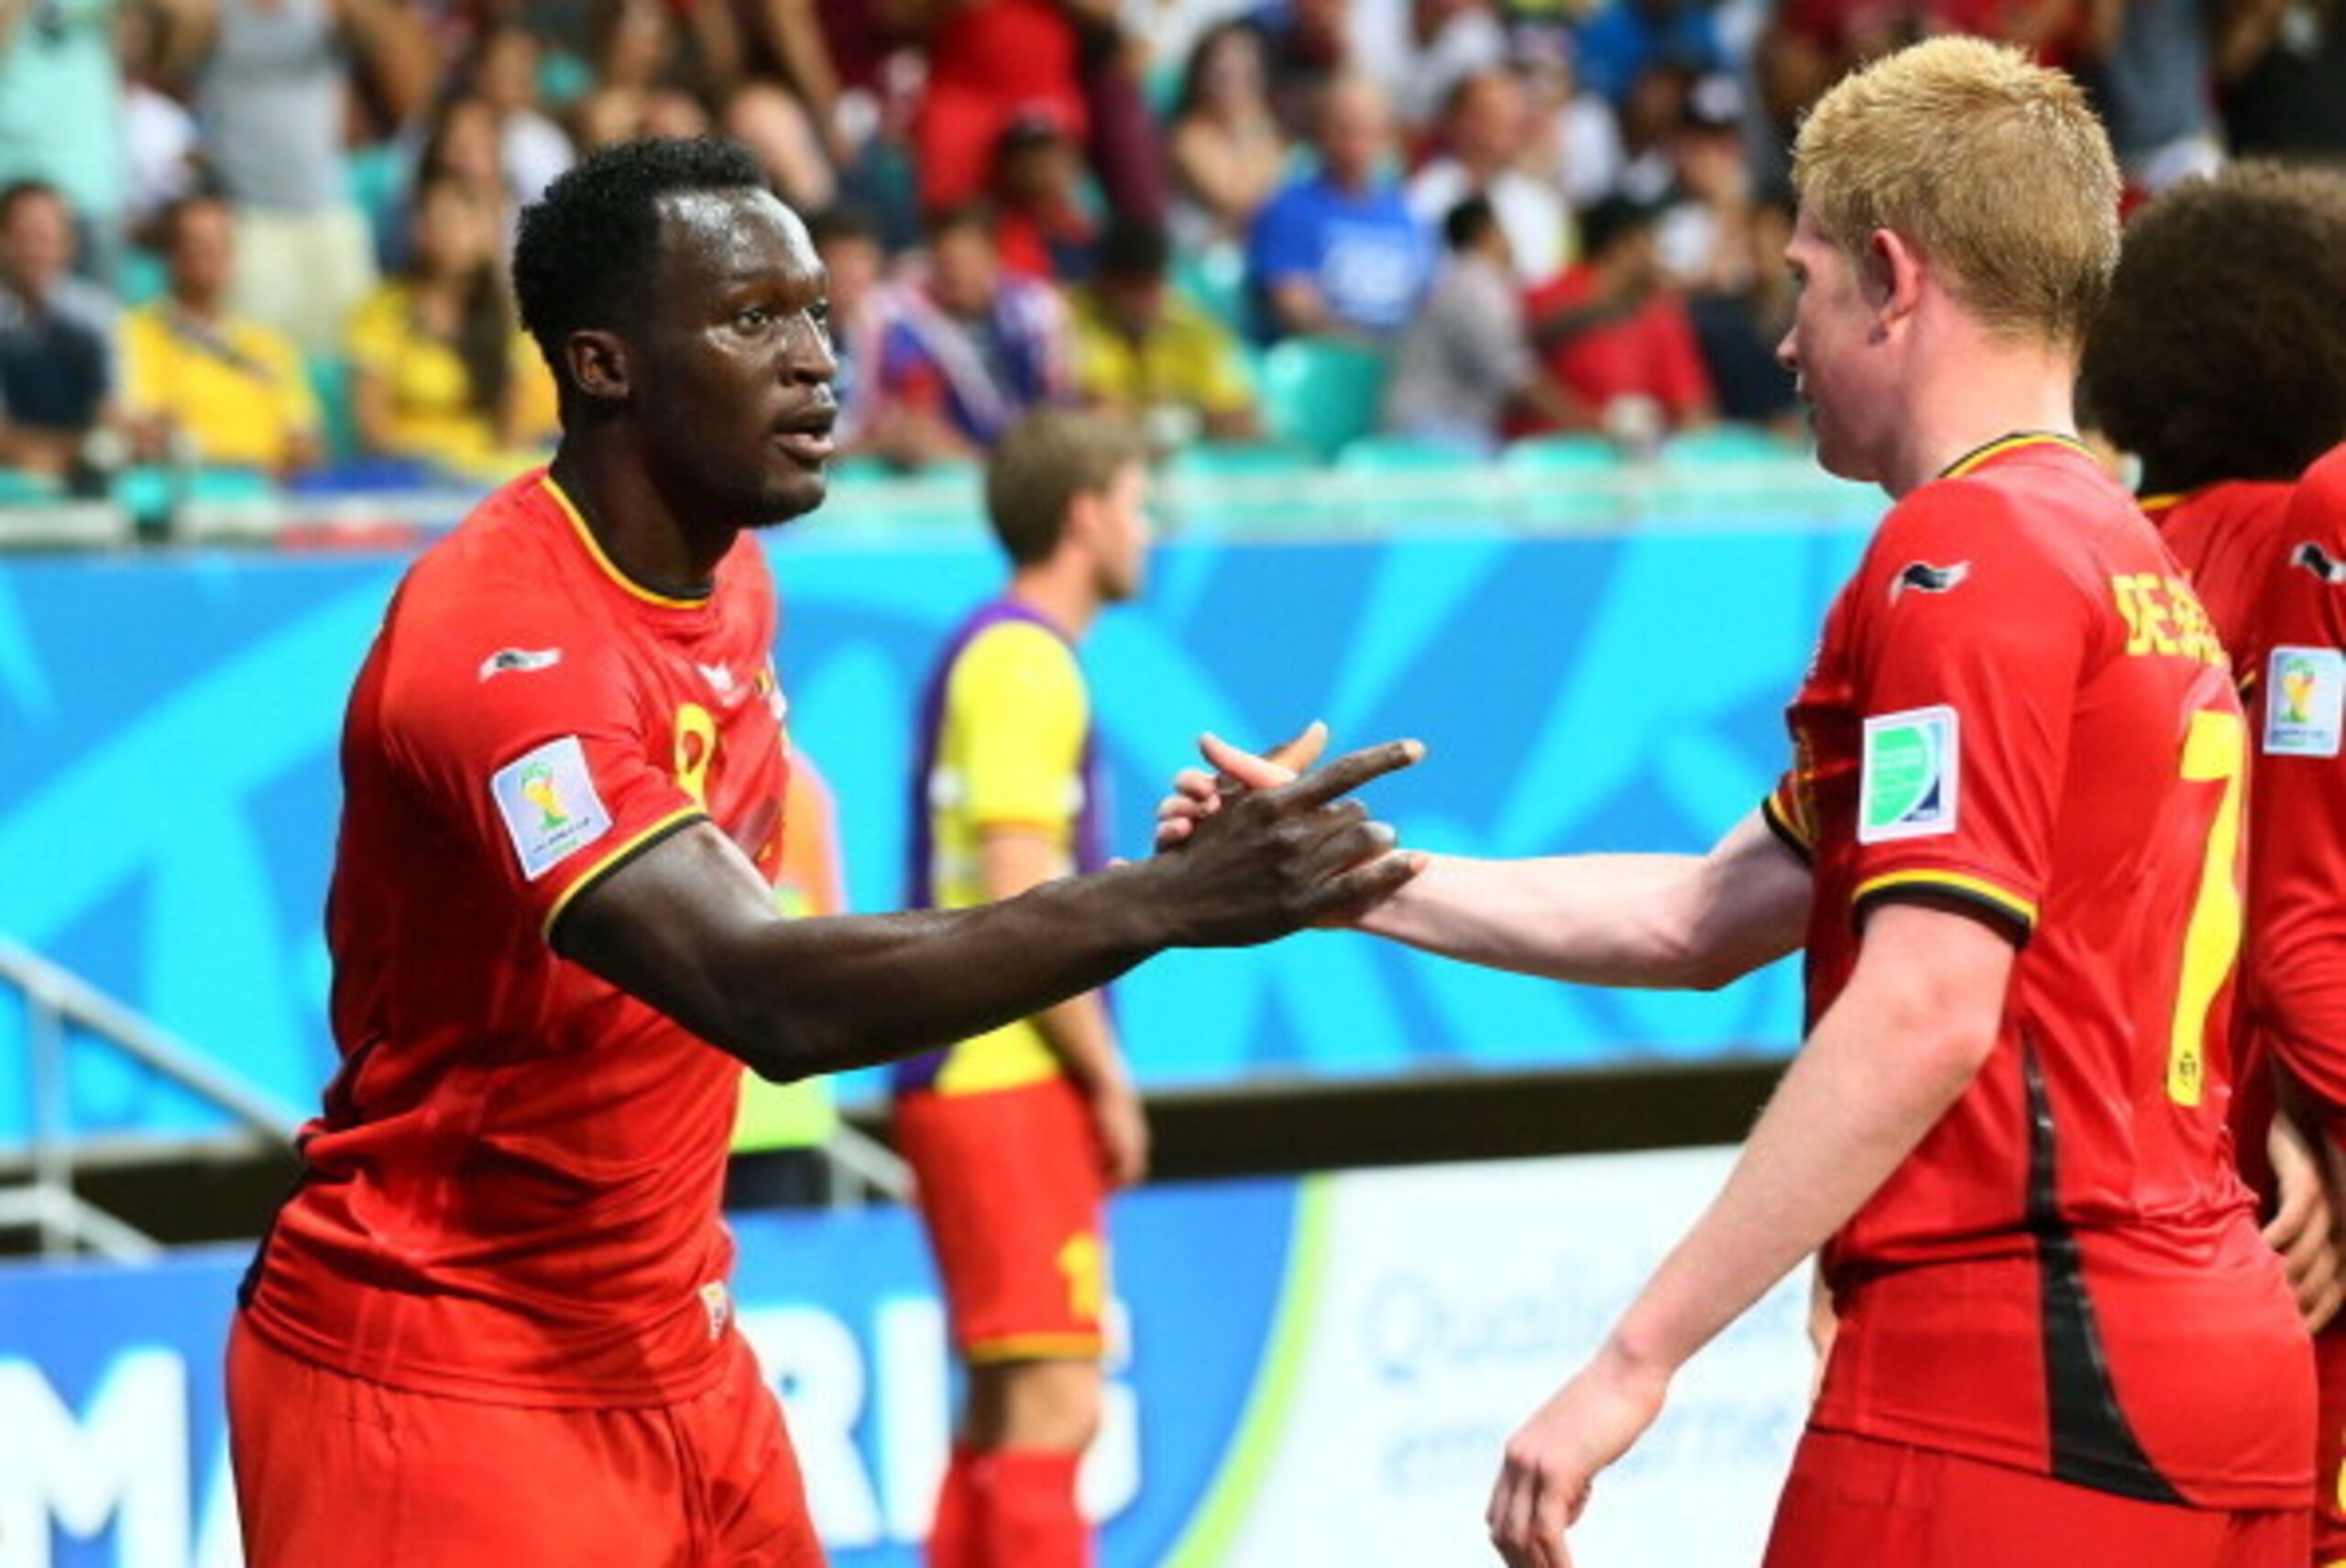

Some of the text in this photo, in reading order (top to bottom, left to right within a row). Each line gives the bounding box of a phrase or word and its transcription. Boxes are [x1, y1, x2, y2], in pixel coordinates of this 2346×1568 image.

[2111, 572, 2178, 657] DE
[674, 702, 716, 810] 9
[2166, 709, 2244, 1107] 7
